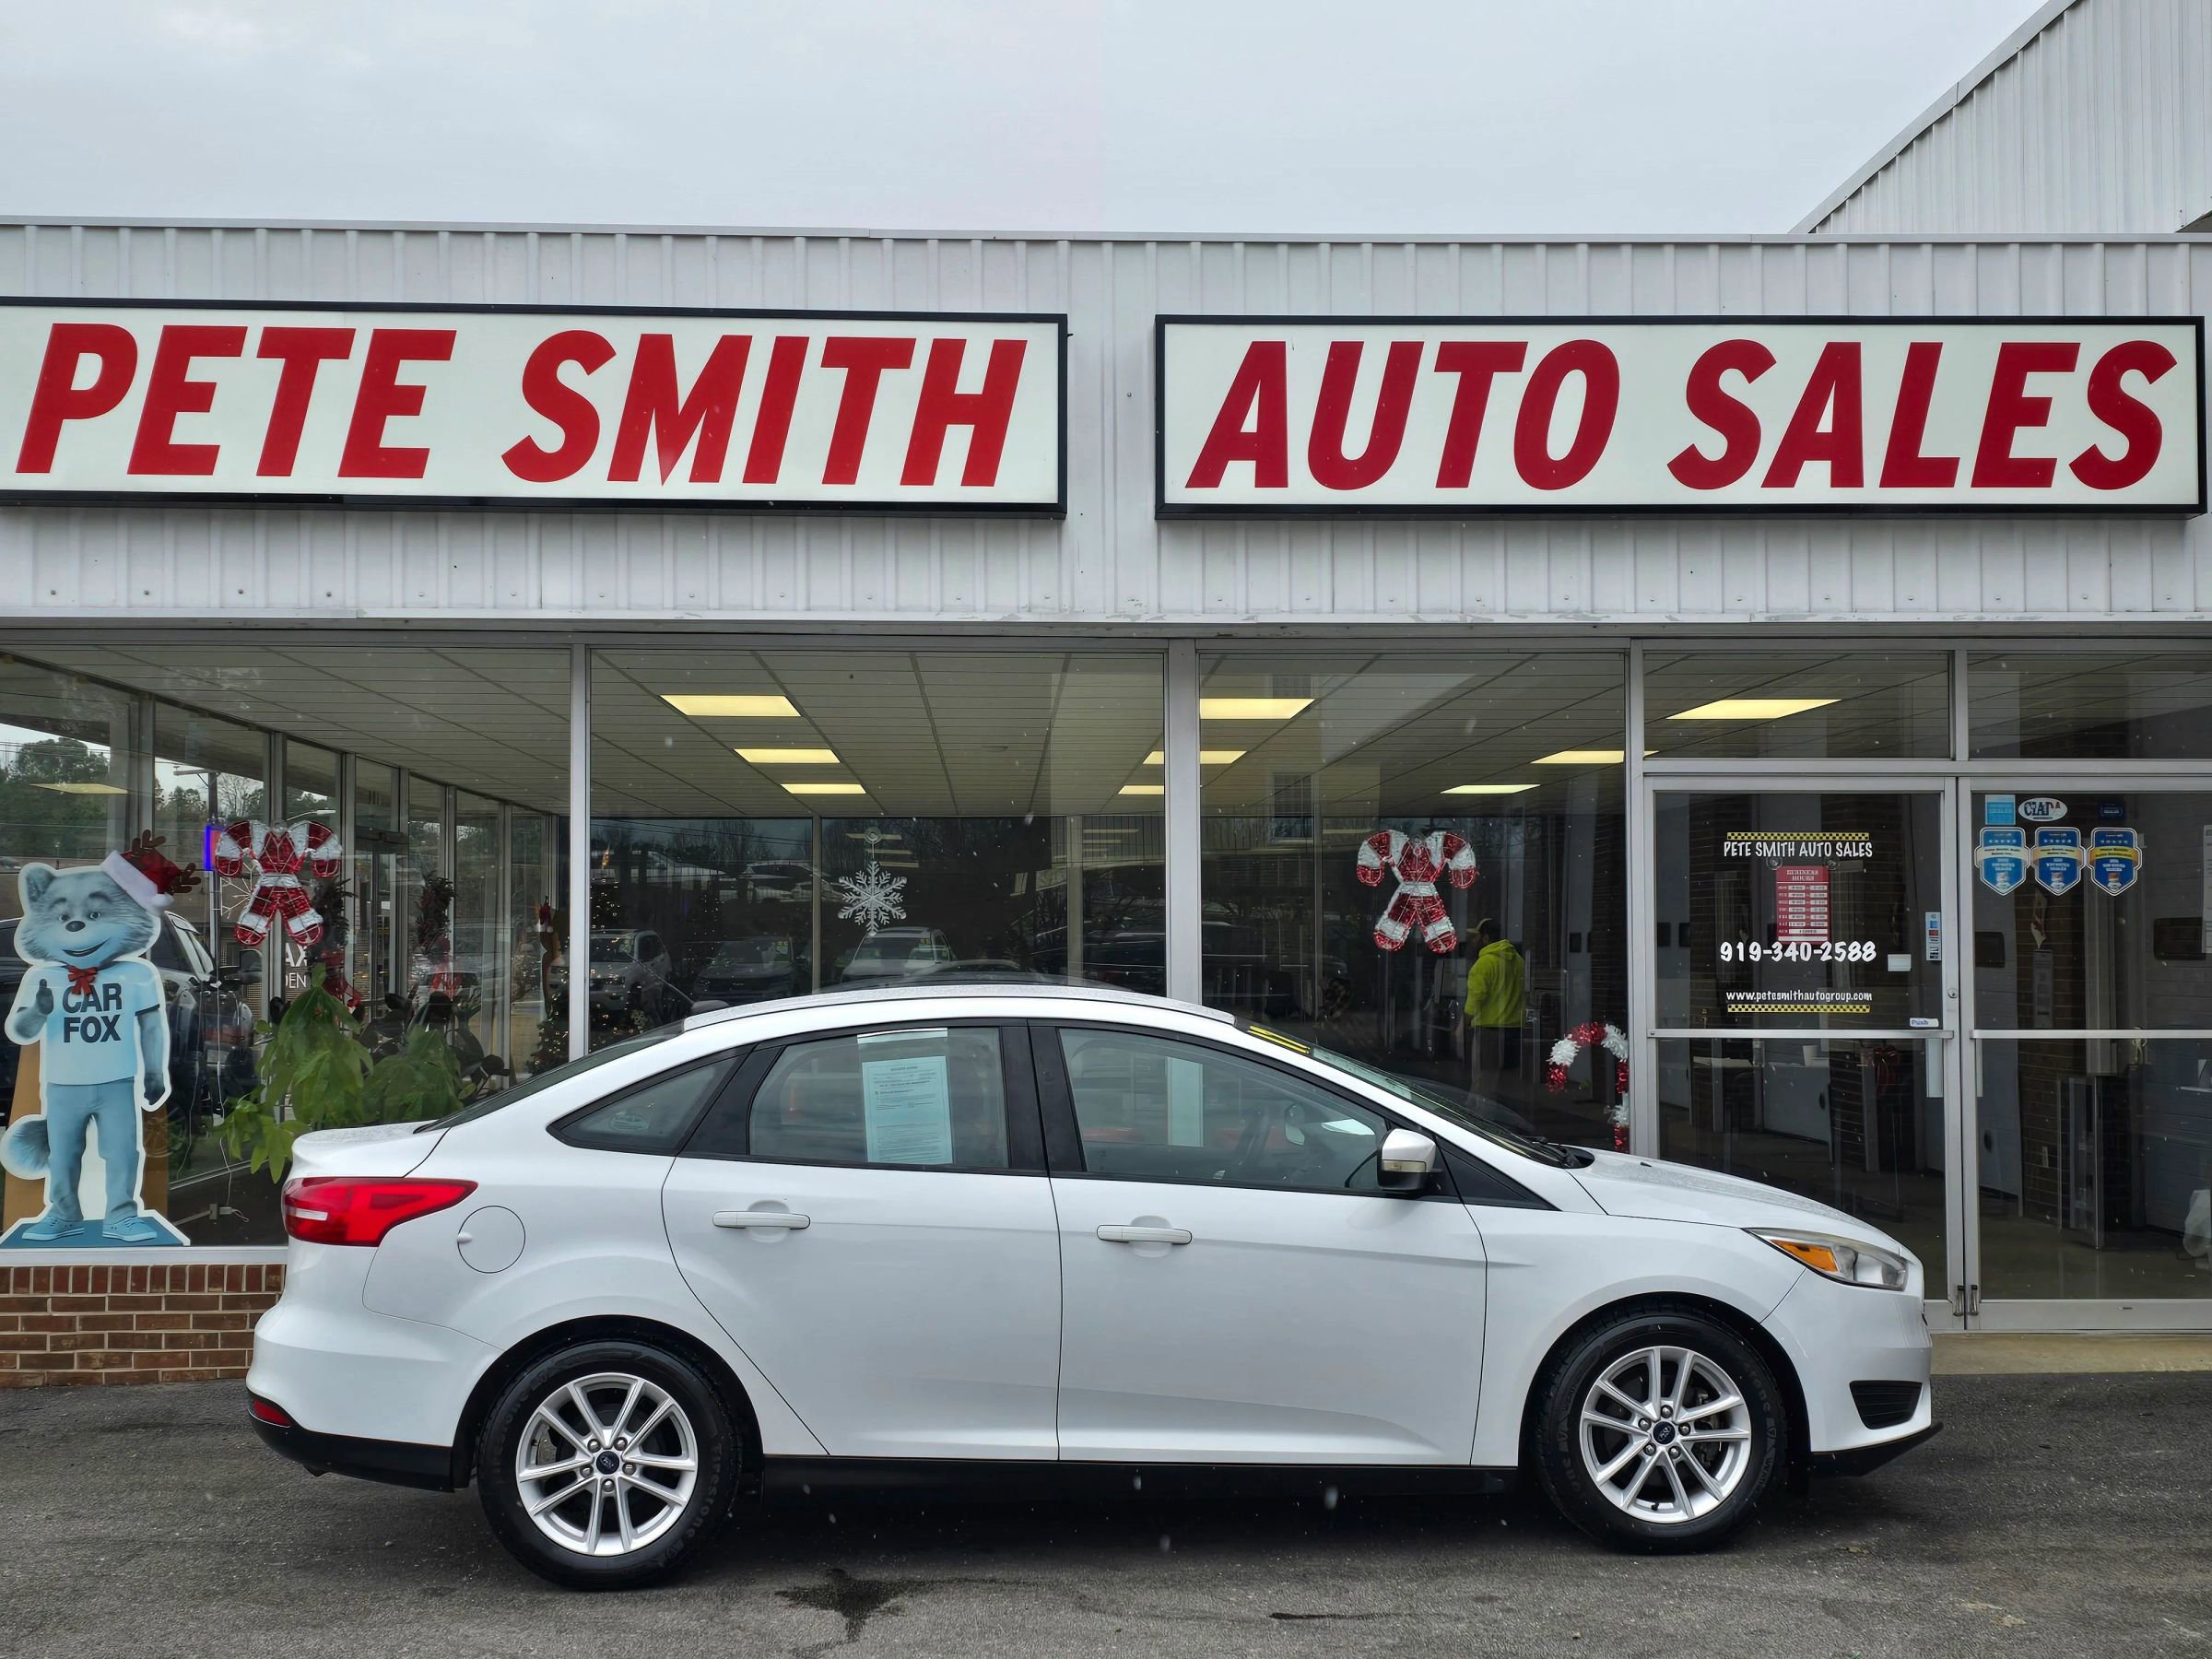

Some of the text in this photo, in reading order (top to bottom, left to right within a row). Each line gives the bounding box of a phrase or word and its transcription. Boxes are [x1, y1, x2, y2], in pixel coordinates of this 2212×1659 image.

[17, 324, 1028, 487] PETE SMITH
[1186, 340, 2176, 489] AUTO SALES
[1724, 841, 1873, 857] PETE SMITH AUTO SALES
[1720, 941, 1877, 962] 919-340-2588
[63, 982, 122, 1014] CAR
[1726, 990, 1873, 1003] www.petesmithautogroup.com
[64, 1015, 122, 1043] FOX
